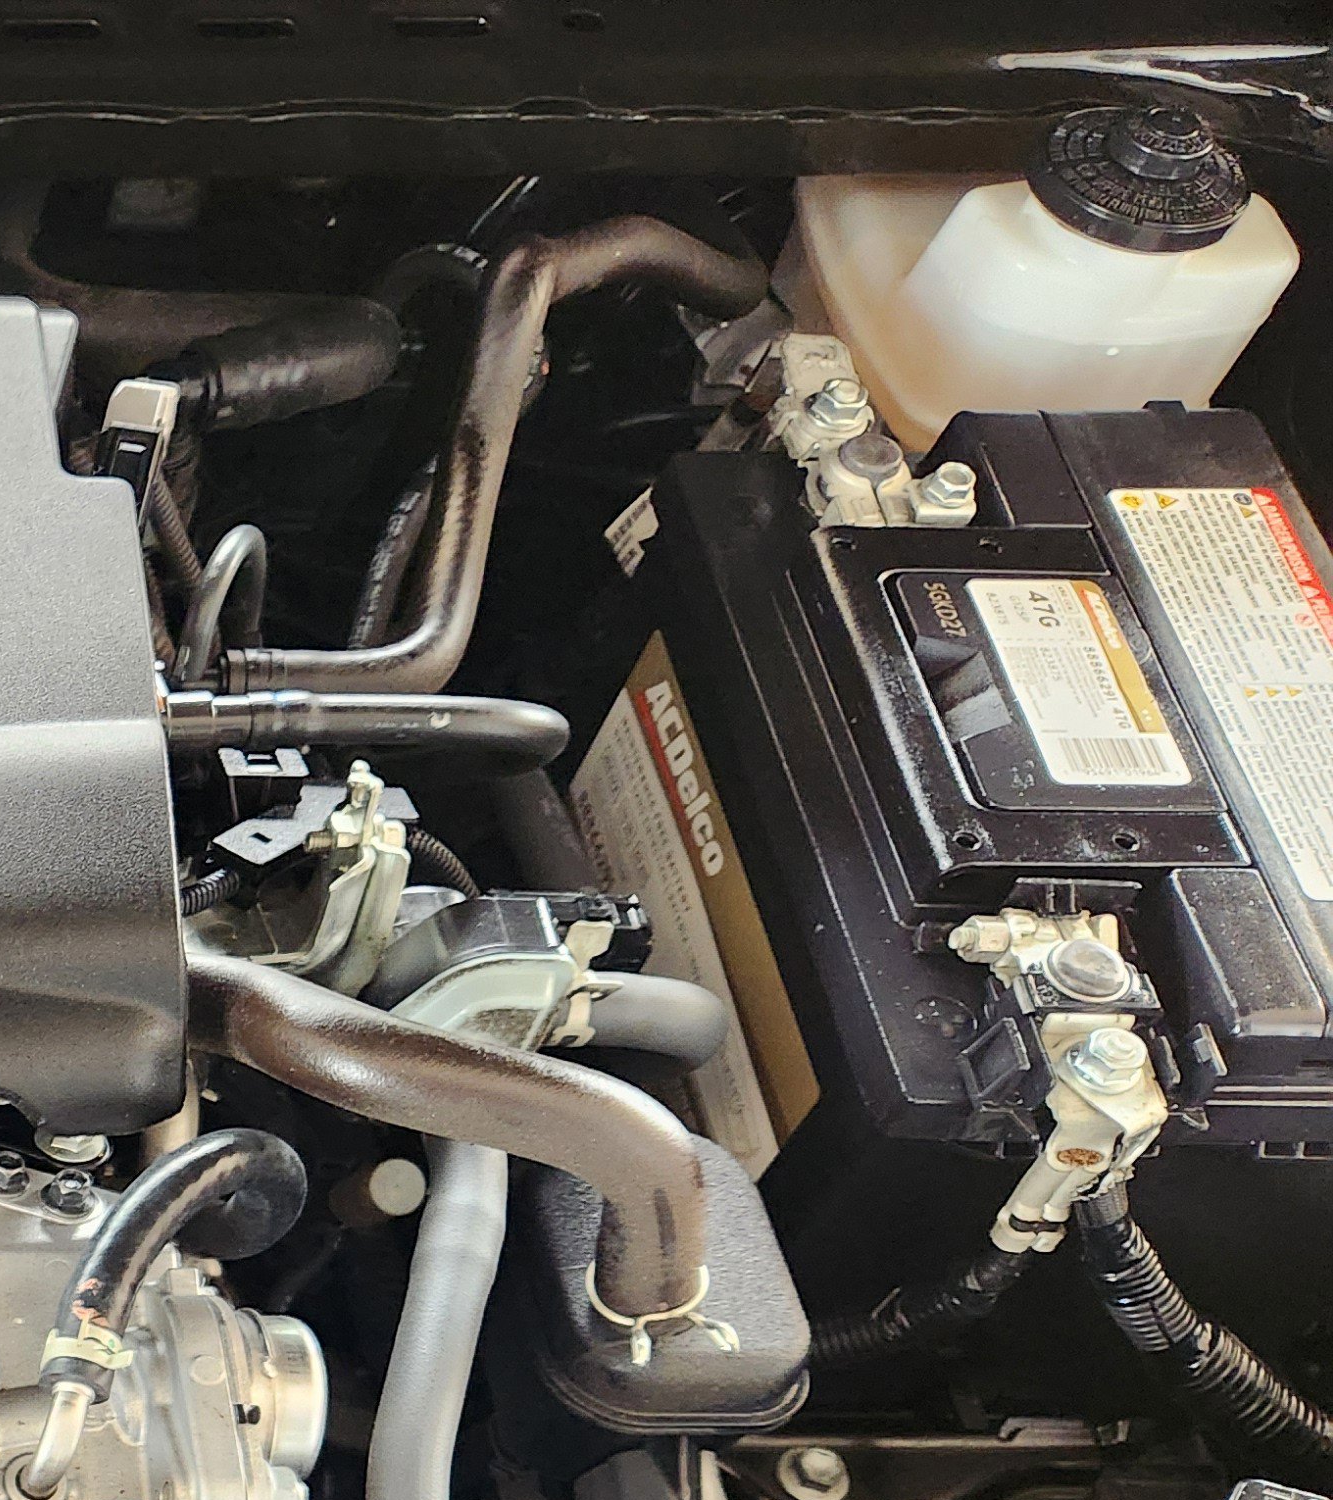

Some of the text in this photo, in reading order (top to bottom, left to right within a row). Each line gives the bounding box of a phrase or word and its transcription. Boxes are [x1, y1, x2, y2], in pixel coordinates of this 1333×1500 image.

[1024, 590, 1062, 628] 47G
[1110, 707, 1132, 729] 47G
[644, 680, 724, 877] ACDelco
